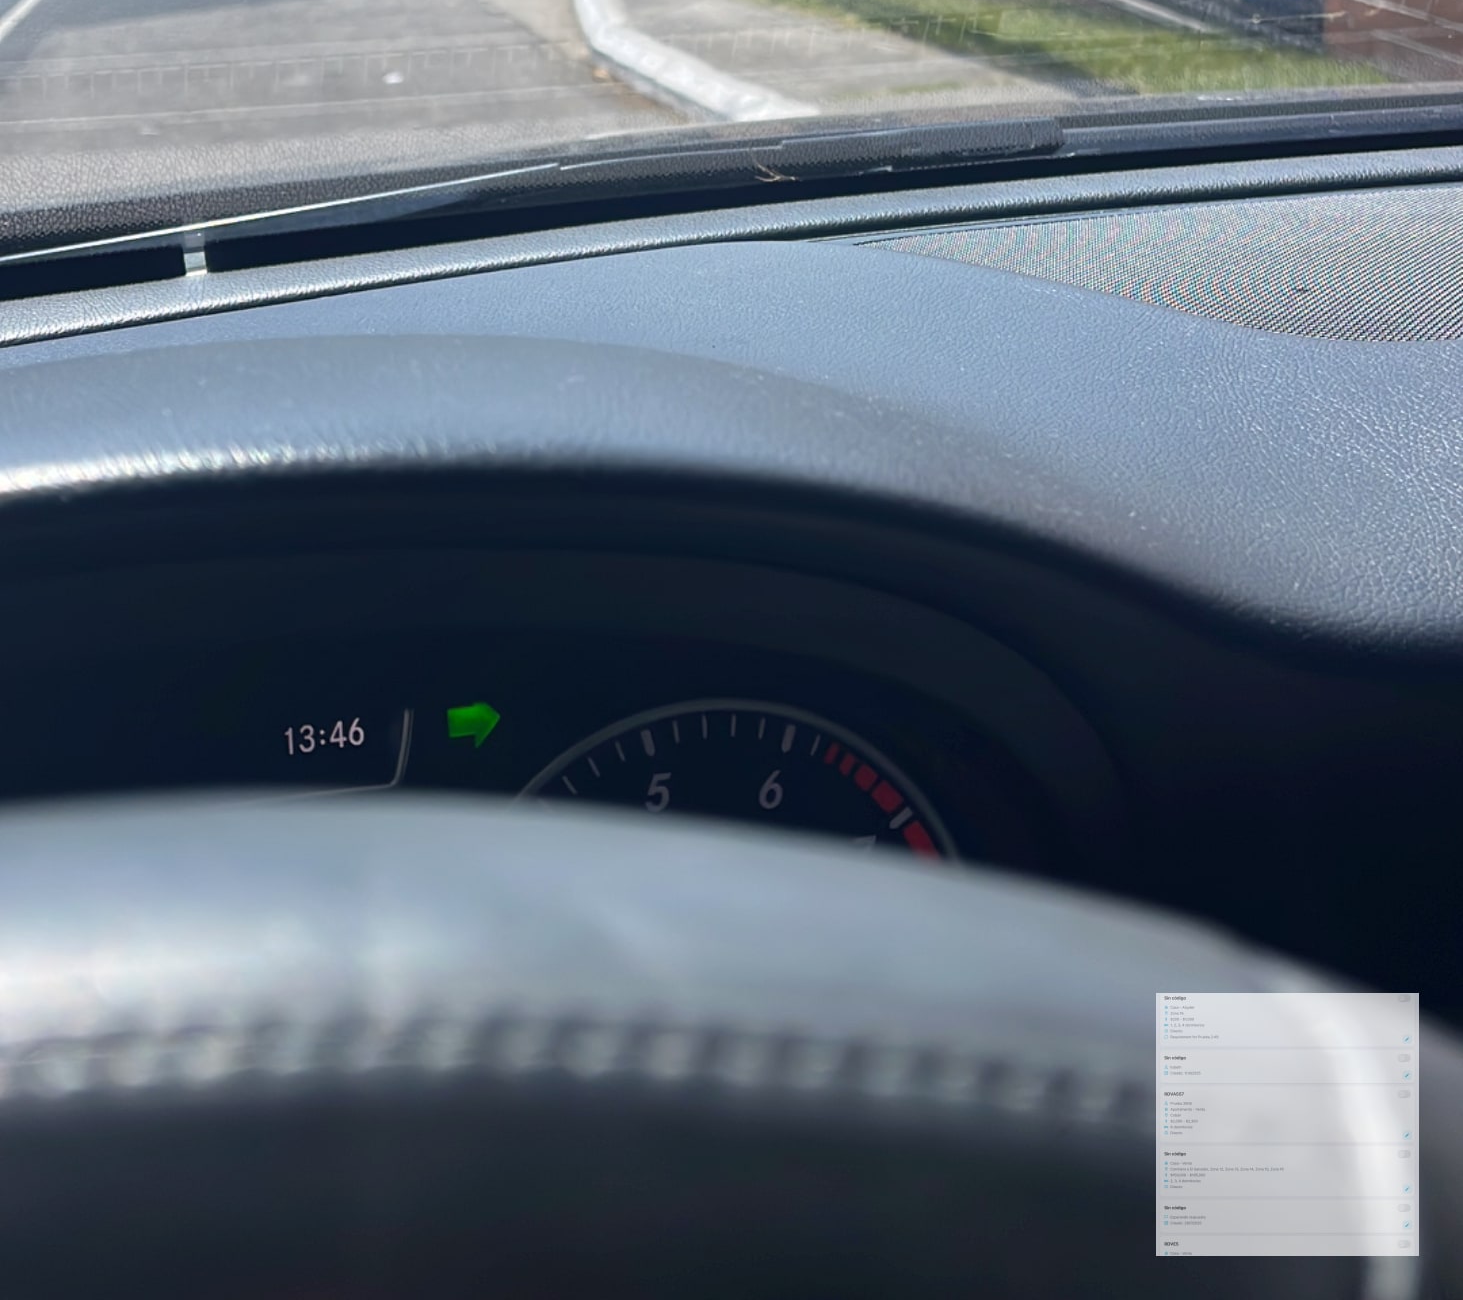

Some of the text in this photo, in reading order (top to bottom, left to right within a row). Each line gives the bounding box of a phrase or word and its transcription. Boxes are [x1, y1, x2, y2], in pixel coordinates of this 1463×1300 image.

[284, 717, 365, 755] 13:46
[645, 772, 672, 813] 5
[759, 770, 784, 810] 6
